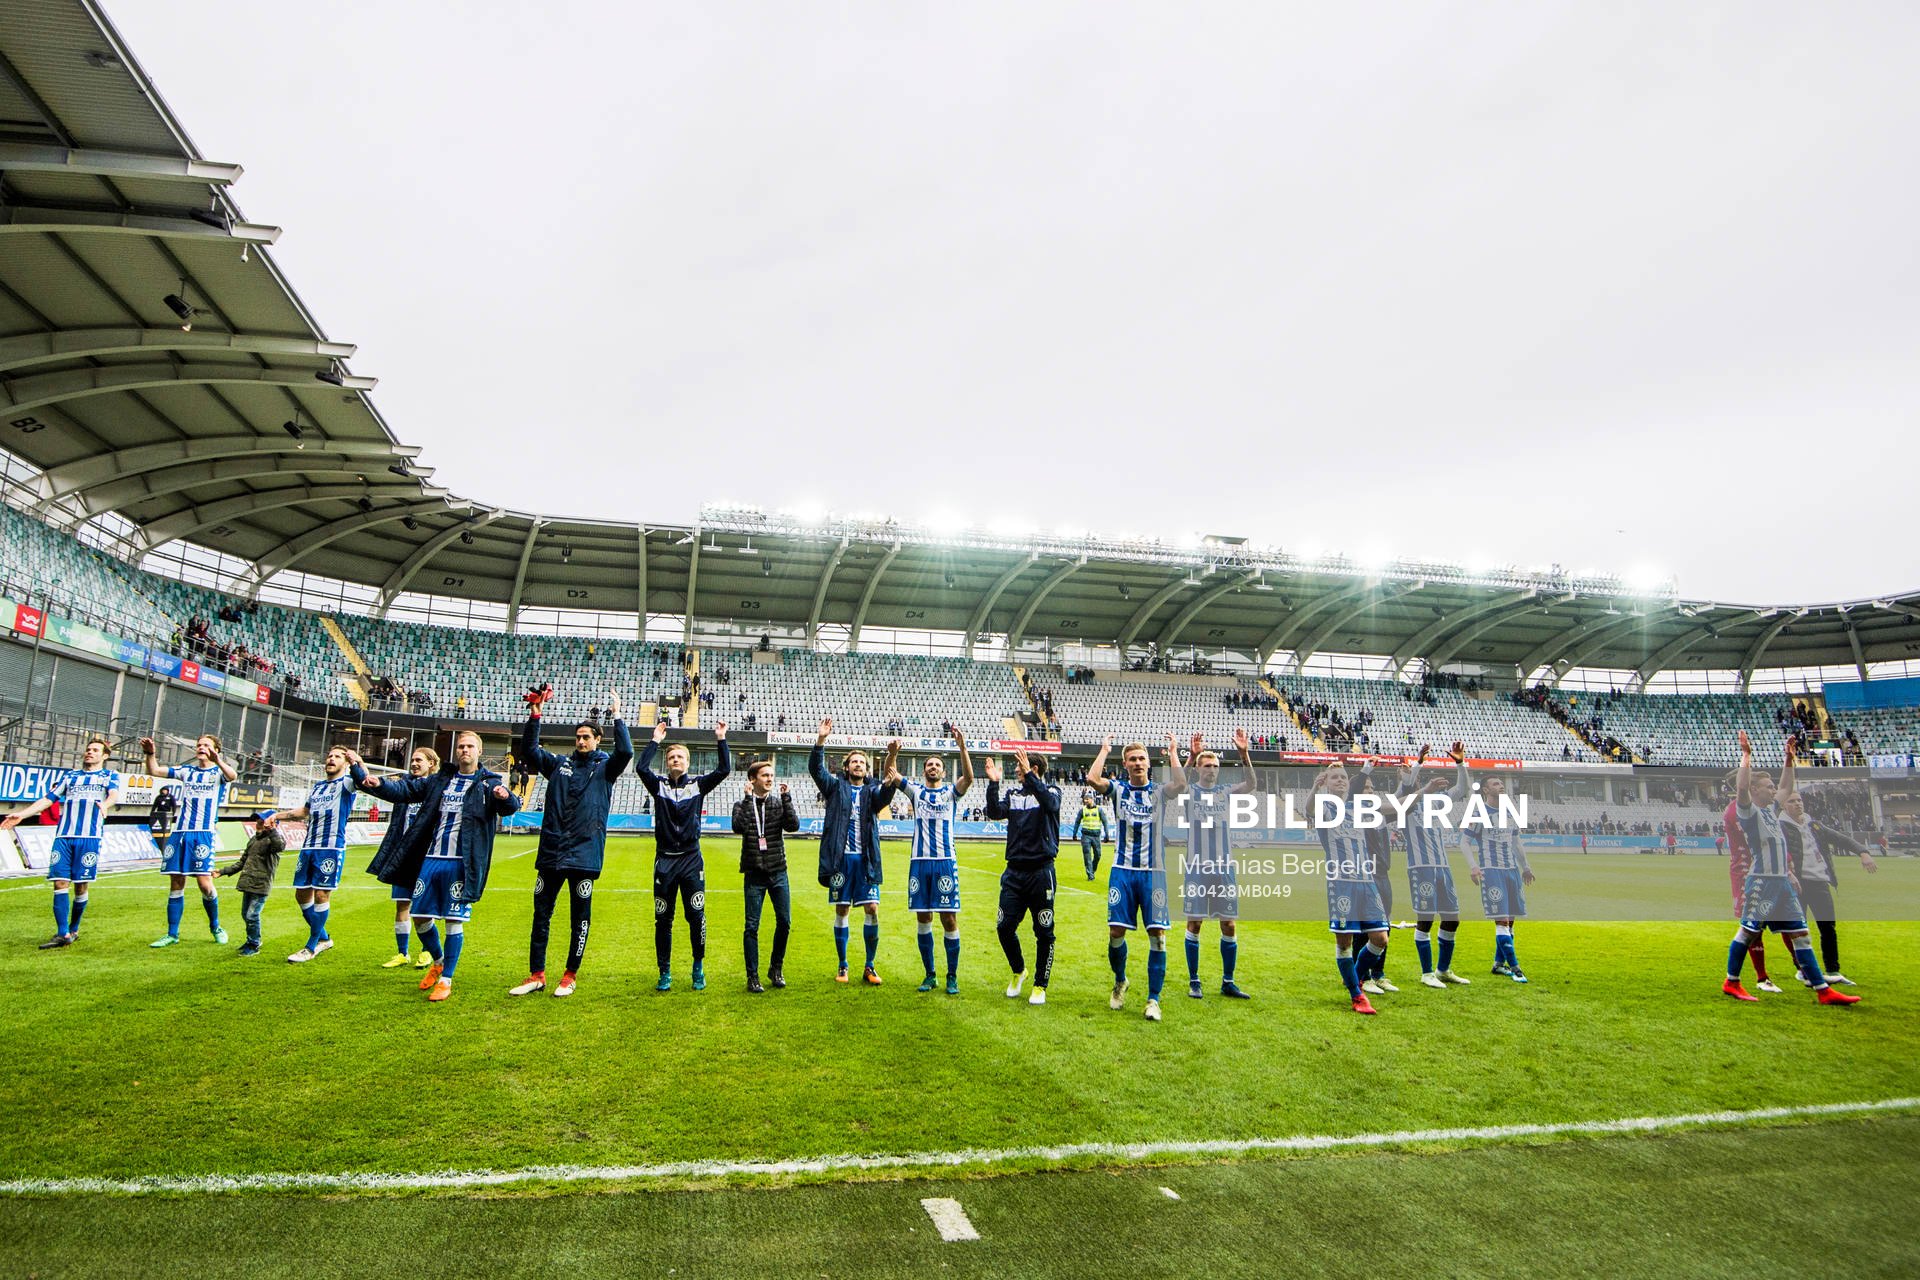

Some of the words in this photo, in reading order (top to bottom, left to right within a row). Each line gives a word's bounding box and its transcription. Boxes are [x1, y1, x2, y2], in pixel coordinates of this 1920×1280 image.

[10, 416, 45, 433] B3
[443, 577, 465, 586] D1
[567, 590, 589, 598] D2
[740, 601, 761, 609] D3
[905, 610, 925, 619] D4
[1060, 620, 1080, 628] D5
[771, 735, 791, 743] RASTA
[848, 737, 867, 746] RASTA
[872, 738, 888, 746] RAST
[878, 824, 898, 833] ASTA
[1229, 831, 1262, 840] TEBORG
[868, 888, 878, 897] 42
[940, 896, 950, 904] 26
[450, 903, 460, 911] 16
